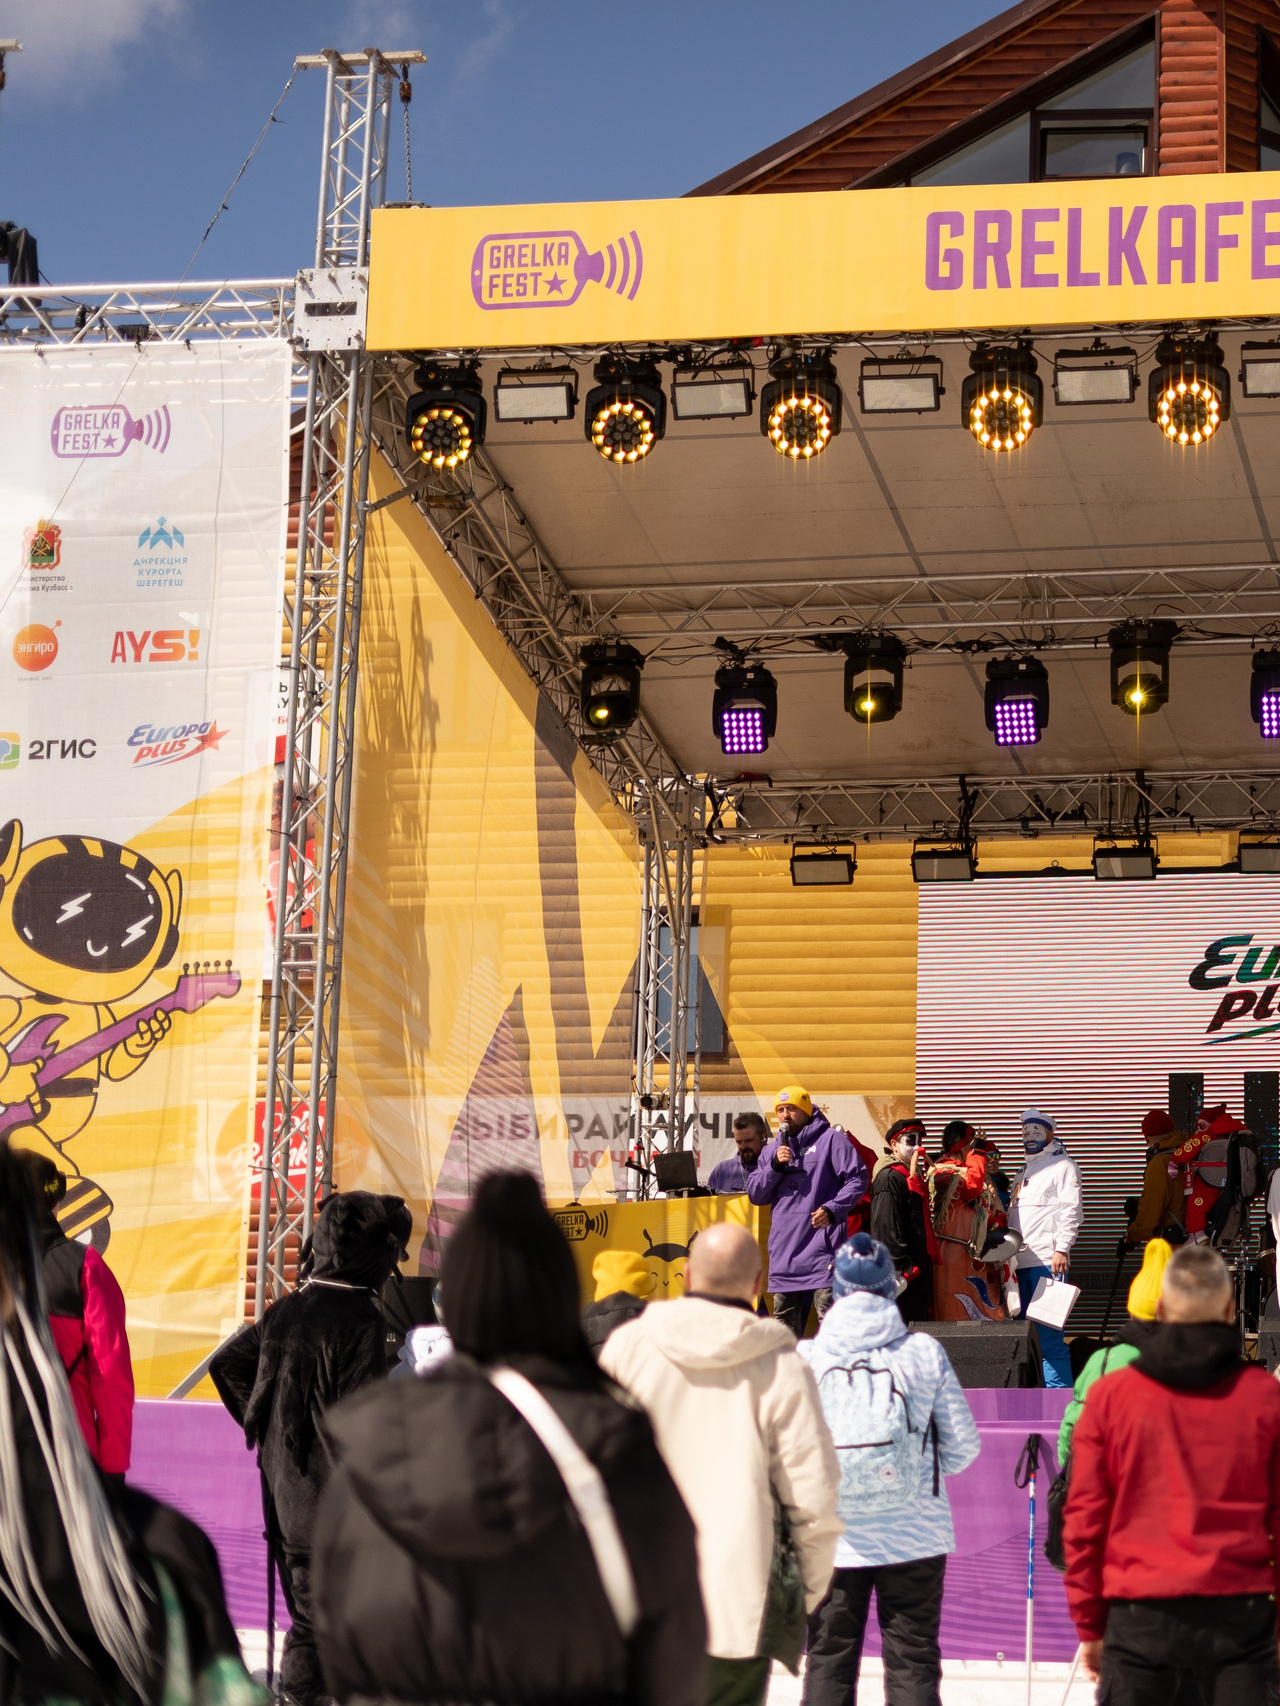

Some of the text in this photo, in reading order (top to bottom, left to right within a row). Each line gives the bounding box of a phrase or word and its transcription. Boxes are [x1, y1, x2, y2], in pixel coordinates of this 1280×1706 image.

[489, 241, 570, 269] GRELKA
[488, 271, 543, 299] FEST
[63, 411, 121, 433] GRELKA
[62, 433, 102, 452] FEST
[133, 557, 188, 567] ДИРЕКЦИЯ
[18, 575, 66, 583] инистерство
[138, 568, 183, 576] КУРОРТА
[136, 579, 183, 587] ШЕРЕГЕШ
[18, 642, 54, 655] энгиро
[110, 629, 201, 663] AYS!
[28, 737, 98, 761] 2ГИС
[560, 1227, 576, 1237] EST
